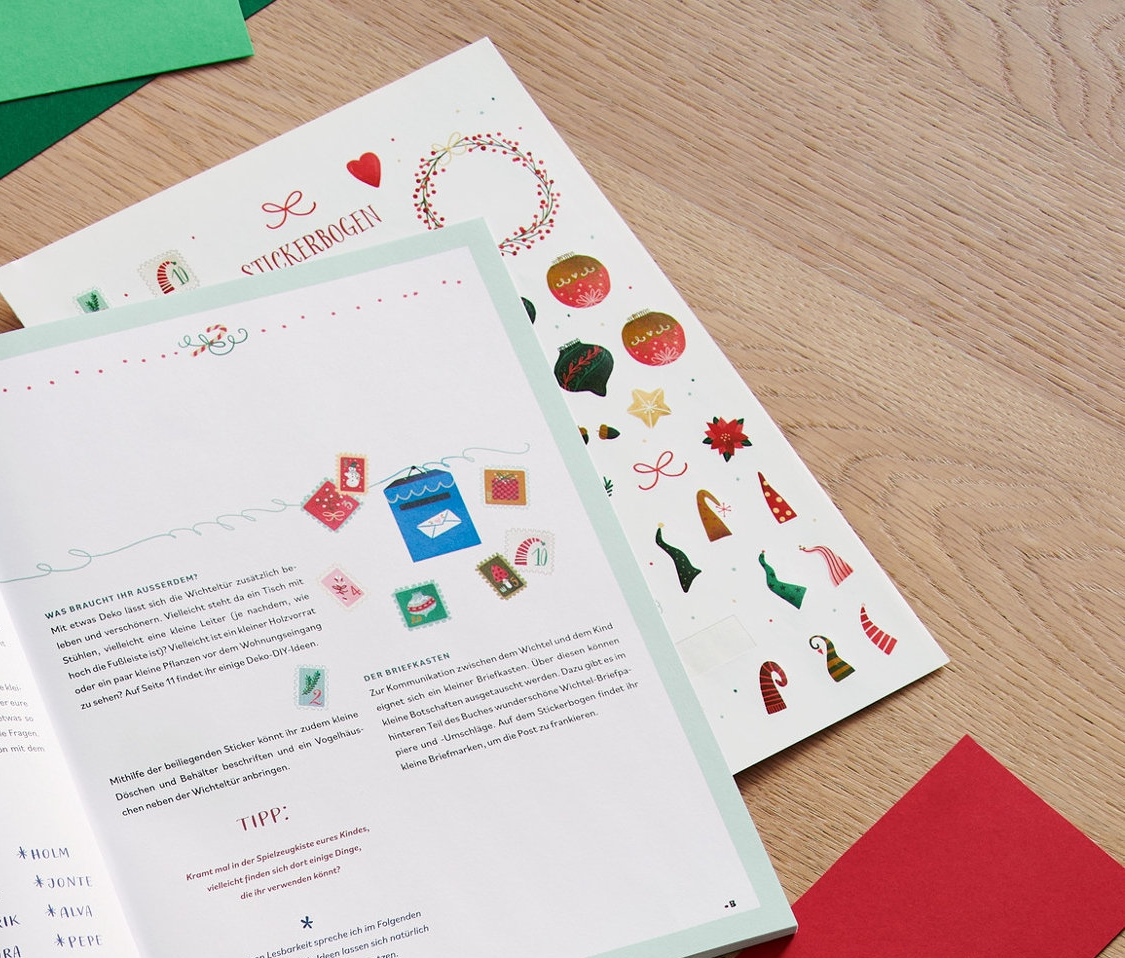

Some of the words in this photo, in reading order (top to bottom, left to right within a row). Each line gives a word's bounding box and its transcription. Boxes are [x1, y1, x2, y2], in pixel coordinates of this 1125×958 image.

[531, 547, 548, 567] 10
[44, 607, 67, 620] WAS
[68, 594, 114, 613] BRAUCHT
[116, 590, 134, 600] IHR
[136, 573, 198, 595] AUSSERDEM?
[50, 625, 68, 635] Mit
[69, 617, 97, 629] etwas
[98, 610, 123, 621] Deko
[124, 603, 147, 615] lässt
[148, 597, 167, 609] sich
[169, 594, 183, 603] die
[184, 581, 233, 598] Wichteltür
[235, 568, 280, 586] zusätzlich
[281, 566, 297, 574] be-
[363, 671, 383, 682] DER
[384, 652, 451, 676] BRIEFKASTEN
[368, 687, 385, 697] Zur
[385, 668, 456, 692] Kommunikation
[457, 656, 498, 673] zwischen
[498, 650, 518, 661] dem
[517, 639, 554, 654] Wichtel
[553, 634, 572, 645] und
[572, 630, 593, 640] dem
[592, 622, 614, 634] Kind
[309, 688, 323, 706] 2
[109, 770, 145, 786] Mithilfe
[146, 765, 162, 775] der
[163, 749, 223, 770] beiliegenden
[223, 740, 256, 754] Sticker
[256, 732, 285, 744] könnt
[284, 728, 298, 737] ihr
[300, 720, 331, 733] zudem
[331, 712, 359, 724] kleine
[115, 785, 156, 801] Döschen
[158, 777, 177, 789] und
[179, 766, 219, 783] Behälter
[221, 752, 274, 771] beschriften
[277, 744, 295, 756] und
[298, 741, 312, 750] ein
[314, 727, 364, 745] Vogelhäus-
[121, 805, 145, 817] chen
[145, 797, 174, 810] neben
[175, 791, 191, 801] der
[191, 777, 240, 796] Wichteltür
[242, 765, 291, 782] anbringen.
[236, 806, 288, 831] TIPP:
[31, 847, 70, 860] HOLM
[186, 868, 214, 881] Kramt
[214, 863, 231, 874] mal
[241, 858, 255, 867] der
[256, 841, 315, 863] Spielzeugkiste
[315, 835, 339, 846] eures
[339, 826, 370, 839] Kindes,
[206, 877, 244, 892] vielleicht
[244, 870, 271, 884] finden
[271, 864, 289, 875] sich
[289, 859, 308, 870] dort
[309, 853, 334, 864] einige
[334, 845, 362, 857] Dinge,
[47, 875, 93, 889] JONTE
[240, 891, 253, 900] die
[254, 888, 266, 896] ihr
[267, 875, 312, 892] verwenden
[313, 865, 341, 880] könnt?
[60, 905, 93, 918] ALVA
[313, 932, 348, 947] spreche
[349, 926, 363, 937] ich
[364, 924, 376, 932] im
[376, 911, 422, 929] Folgenden
[68, 934, 103, 948] PEPE
[341, 942, 370, 955] lassen
[370, 936, 388, 947] sich
[390, 924, 430, 942] natürlich
